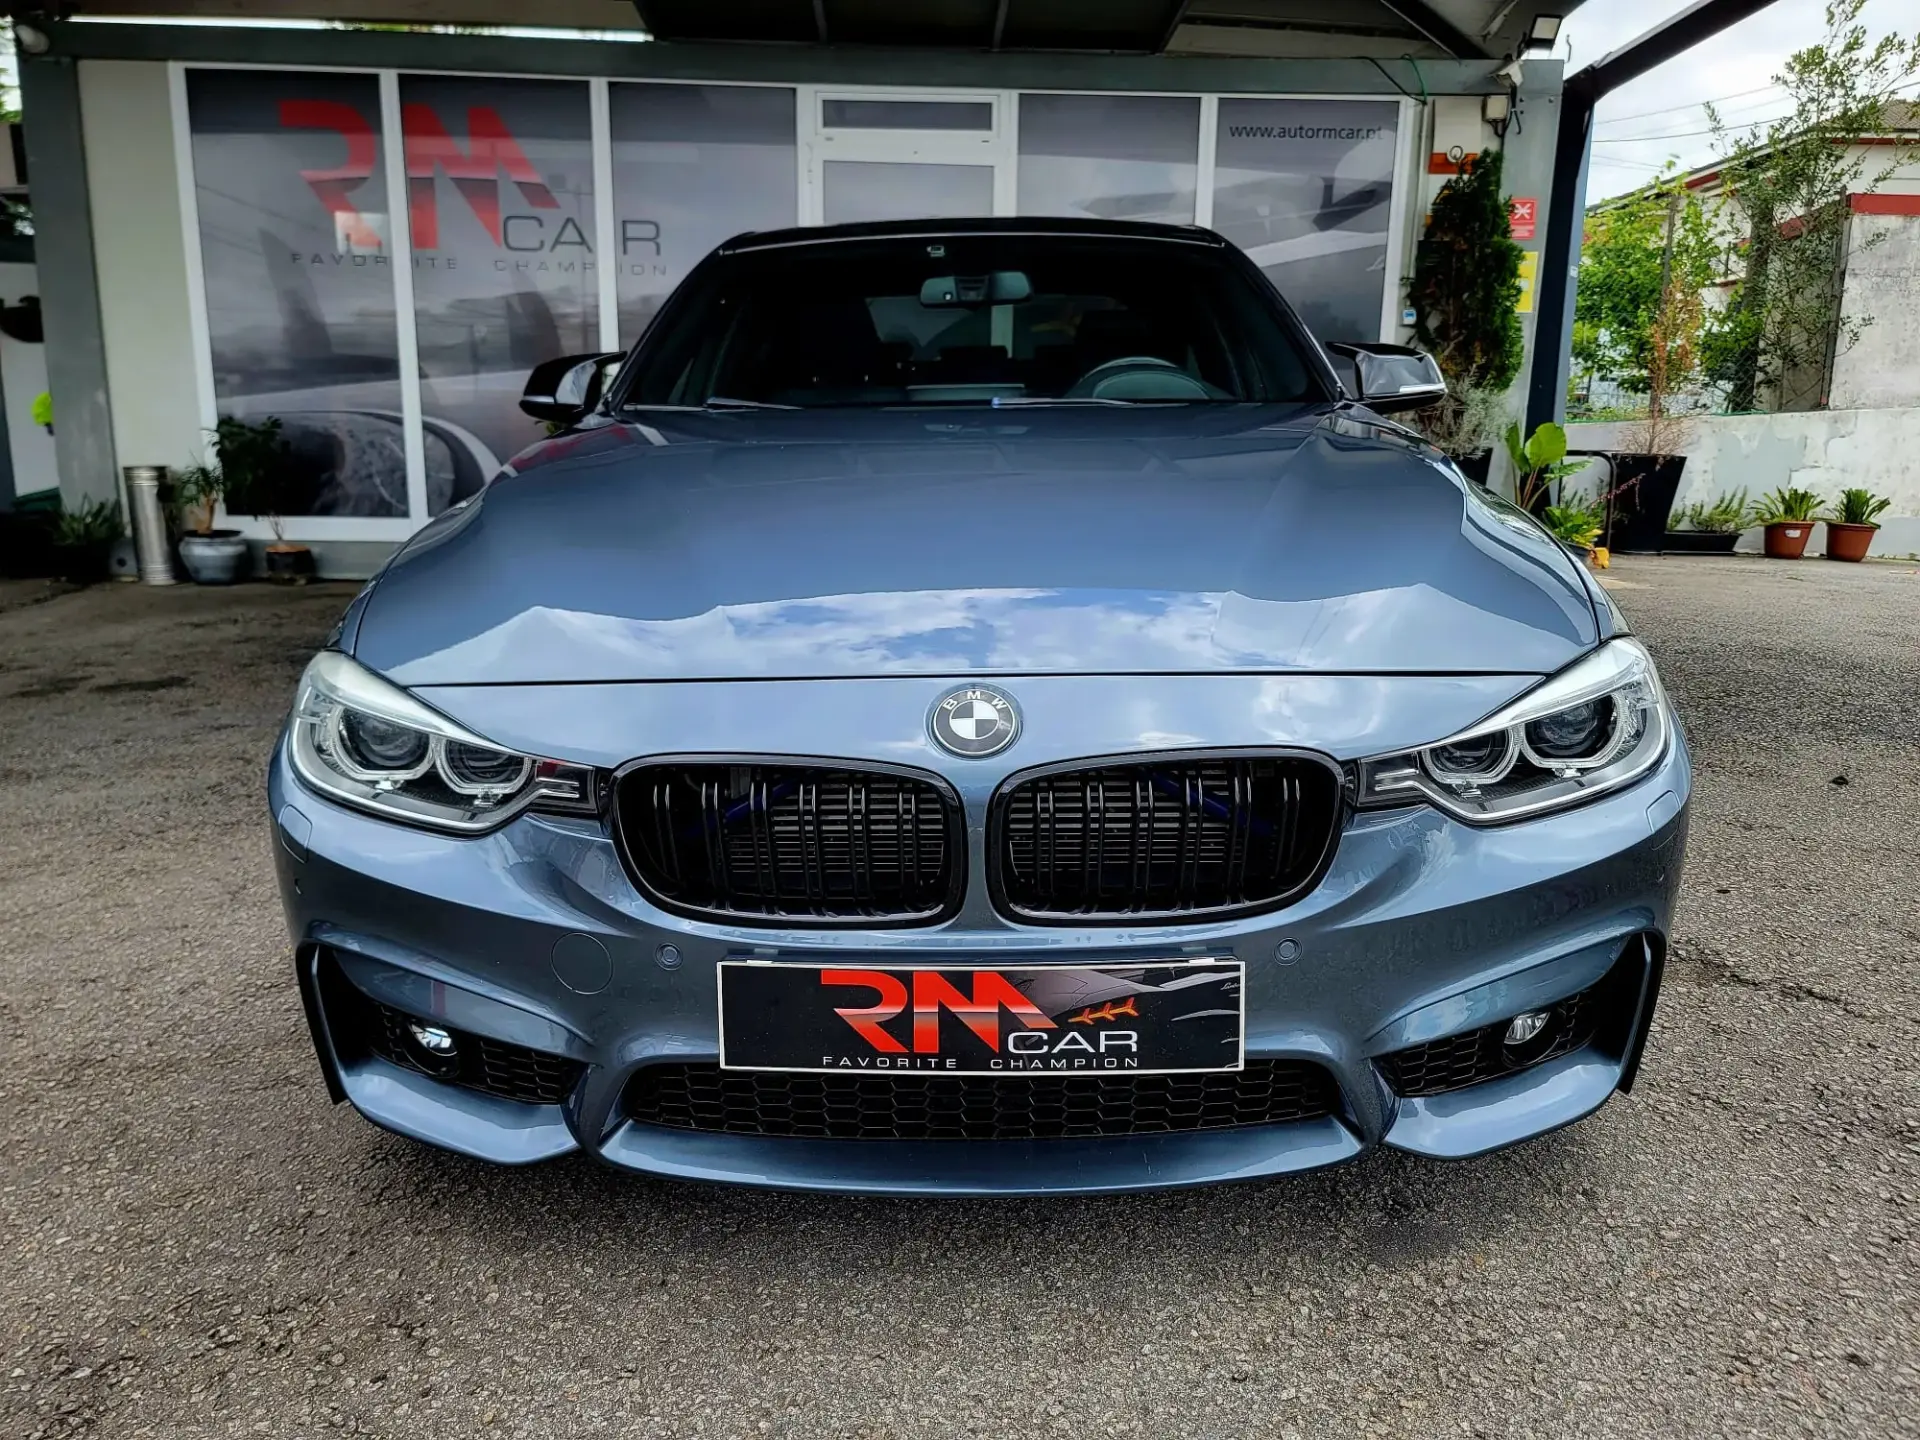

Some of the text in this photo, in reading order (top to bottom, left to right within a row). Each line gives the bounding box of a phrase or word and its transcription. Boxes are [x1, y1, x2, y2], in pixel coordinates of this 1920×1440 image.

[1229, 125, 1385, 141] www.autormcar.pt
[278, 98, 662, 256] RM CAR
[291, 252, 668, 277] FAVORITE CHAMPION
[942, 690, 1008, 711] BMW
[820, 969, 1139, 1054] RM CAR
[822, 1056, 1139, 1069] FAVORITE CHAMPION
